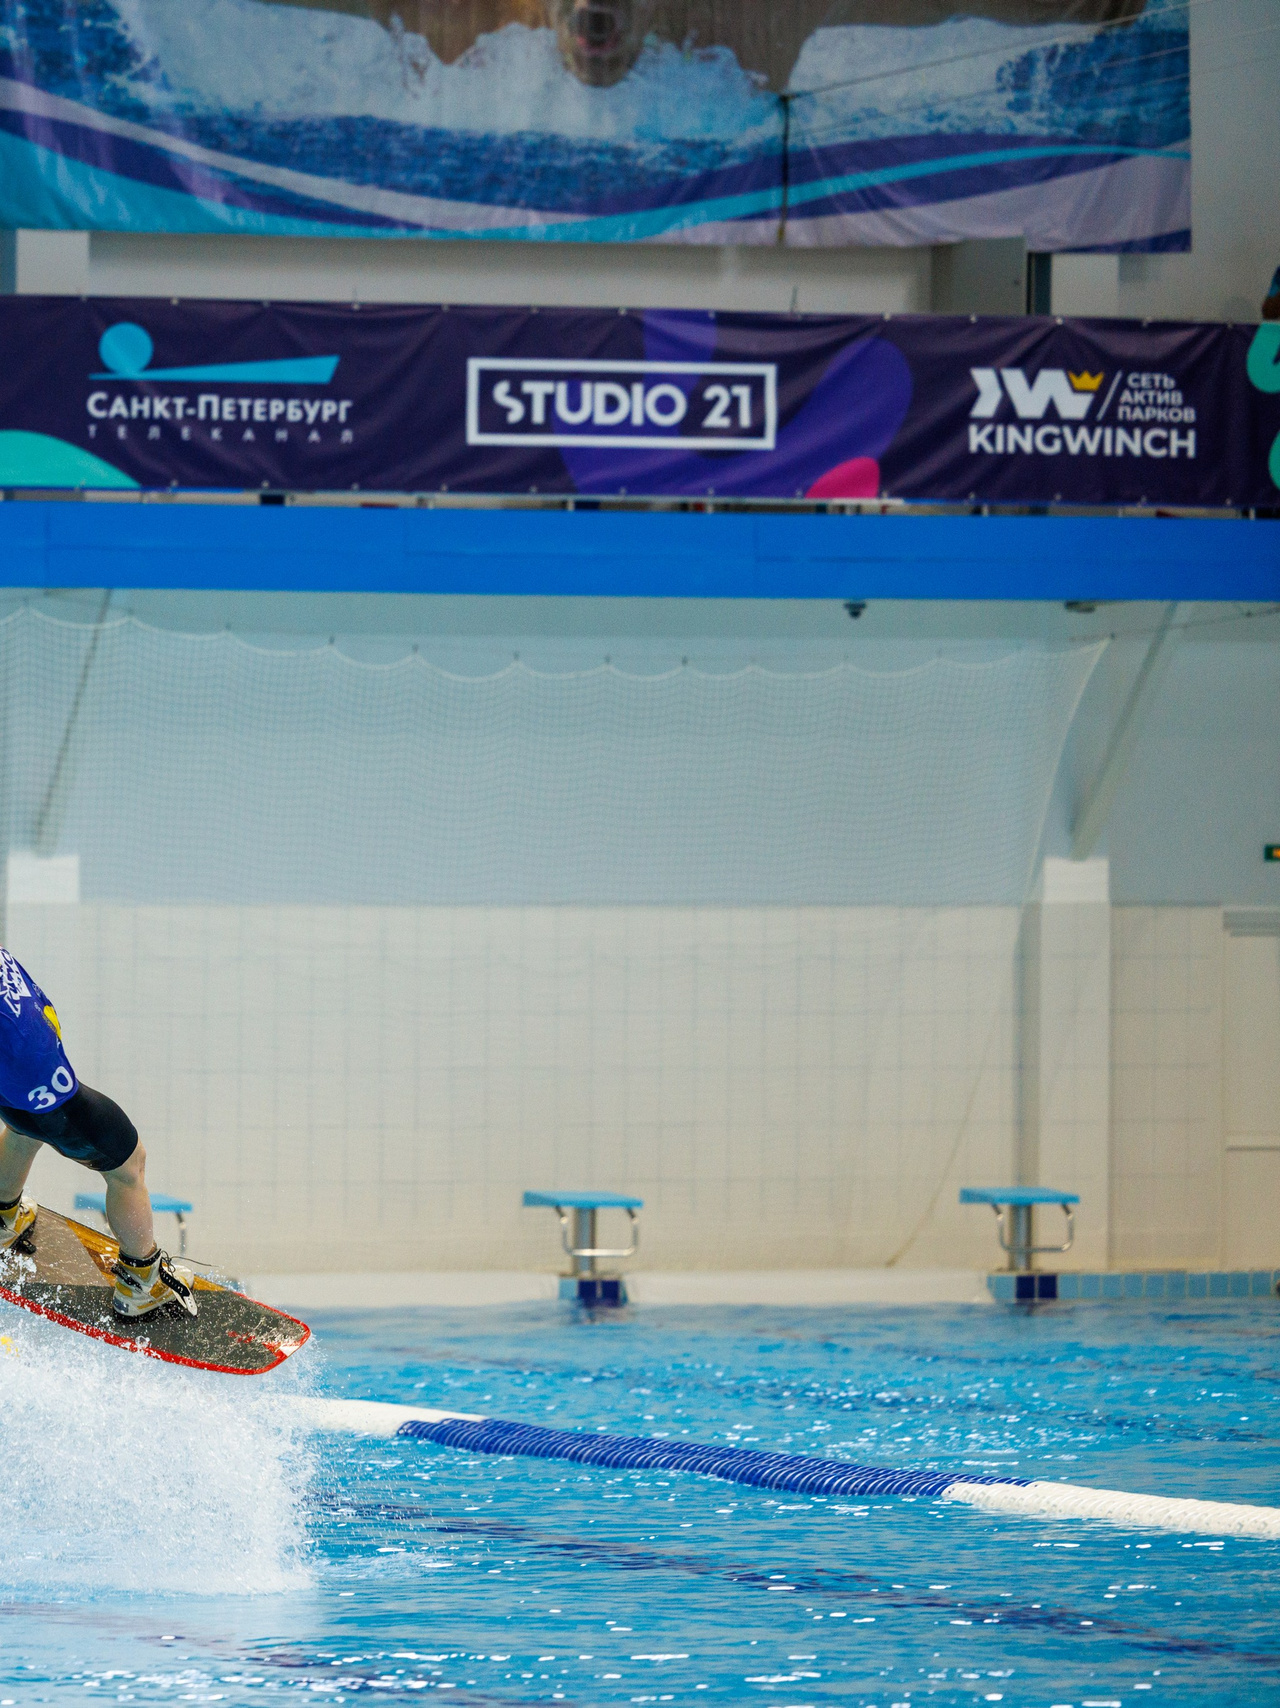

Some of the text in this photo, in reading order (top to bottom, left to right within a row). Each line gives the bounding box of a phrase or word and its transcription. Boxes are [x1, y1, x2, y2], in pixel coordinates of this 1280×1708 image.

[1127, 372, 1176, 390] СЕТЬ
[492, 380, 751, 428] STUDIO 21
[1120, 390, 1183, 406] АКТИВ
[1118, 406, 1196, 423] ПАРКОВ
[968, 424, 1196, 459] KINGWINCH
[27, 1065, 74, 1110] 30
